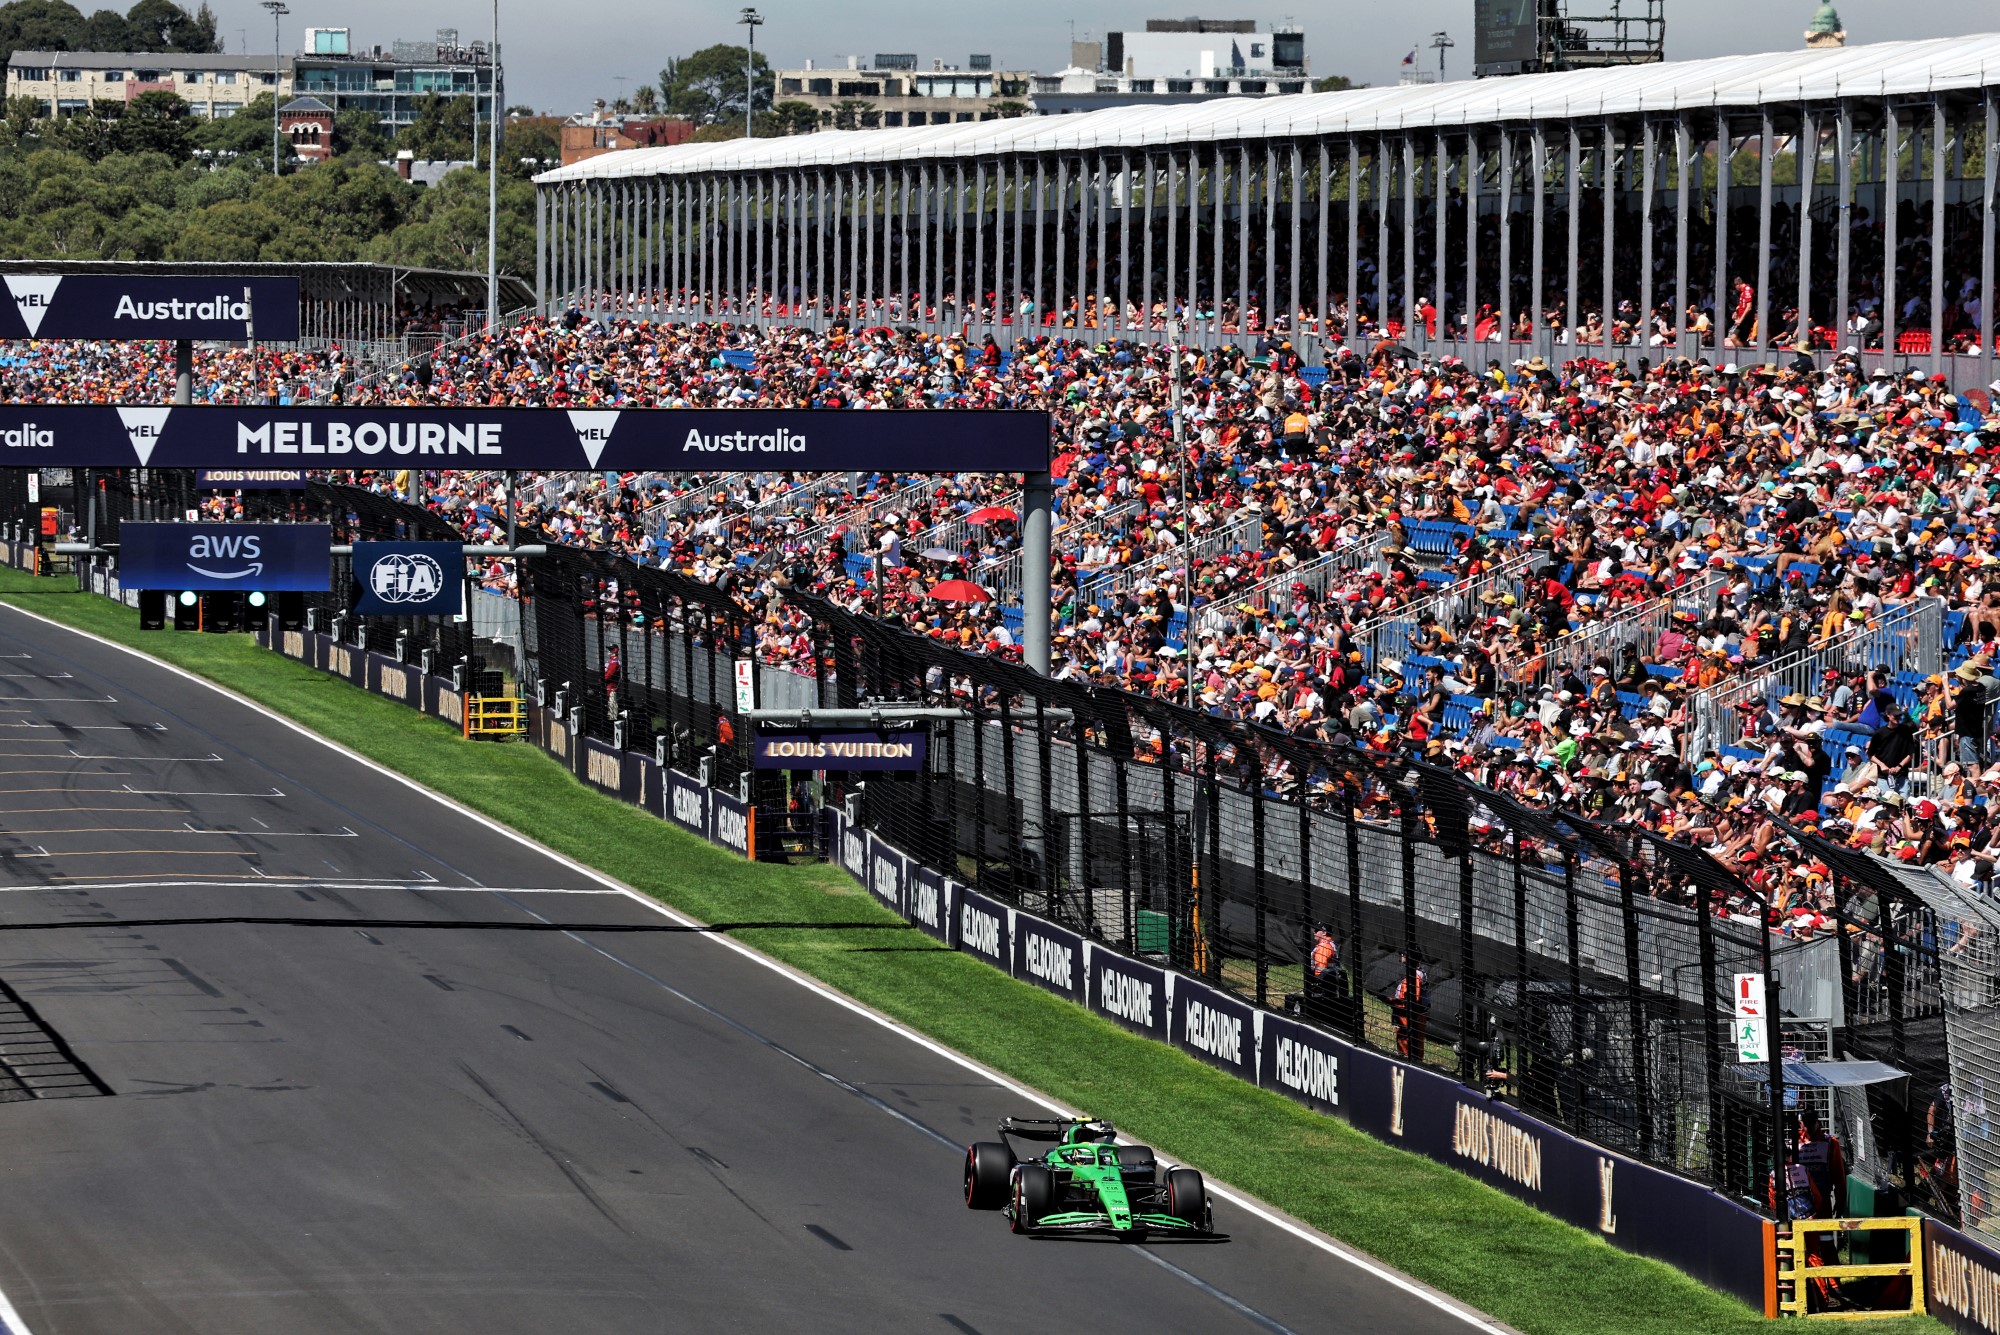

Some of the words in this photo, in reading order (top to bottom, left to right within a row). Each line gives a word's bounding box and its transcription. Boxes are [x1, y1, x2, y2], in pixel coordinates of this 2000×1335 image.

[14, 294, 51, 307] MEL
[114, 294, 248, 320] Australia
[127, 425, 161, 438] MEL
[237, 421, 502, 455] MELBOURNE
[577, 428, 610, 441] MEL
[682, 428, 806, 452] Australia
[206, 470, 244, 481] LOUIS
[247, 470, 300, 482] VUITTON
[189, 534, 261, 559] aws
[767, 741, 826, 758] LOUIS
[831, 741, 913, 758] VUITTON
[1025, 930, 1073, 991] MELBOURNE
[1101, 965, 1153, 1028] MELBOURNE
[1185, 996, 1242, 1066] MELBOURNE
[1276, 1033, 1339, 1106] MELBOURNE
[1454, 1100, 1490, 1167] LOUIS
[1490, 1114, 1542, 1192] VUITTON
[1931, 1239, 1969, 1319] LOUIS
